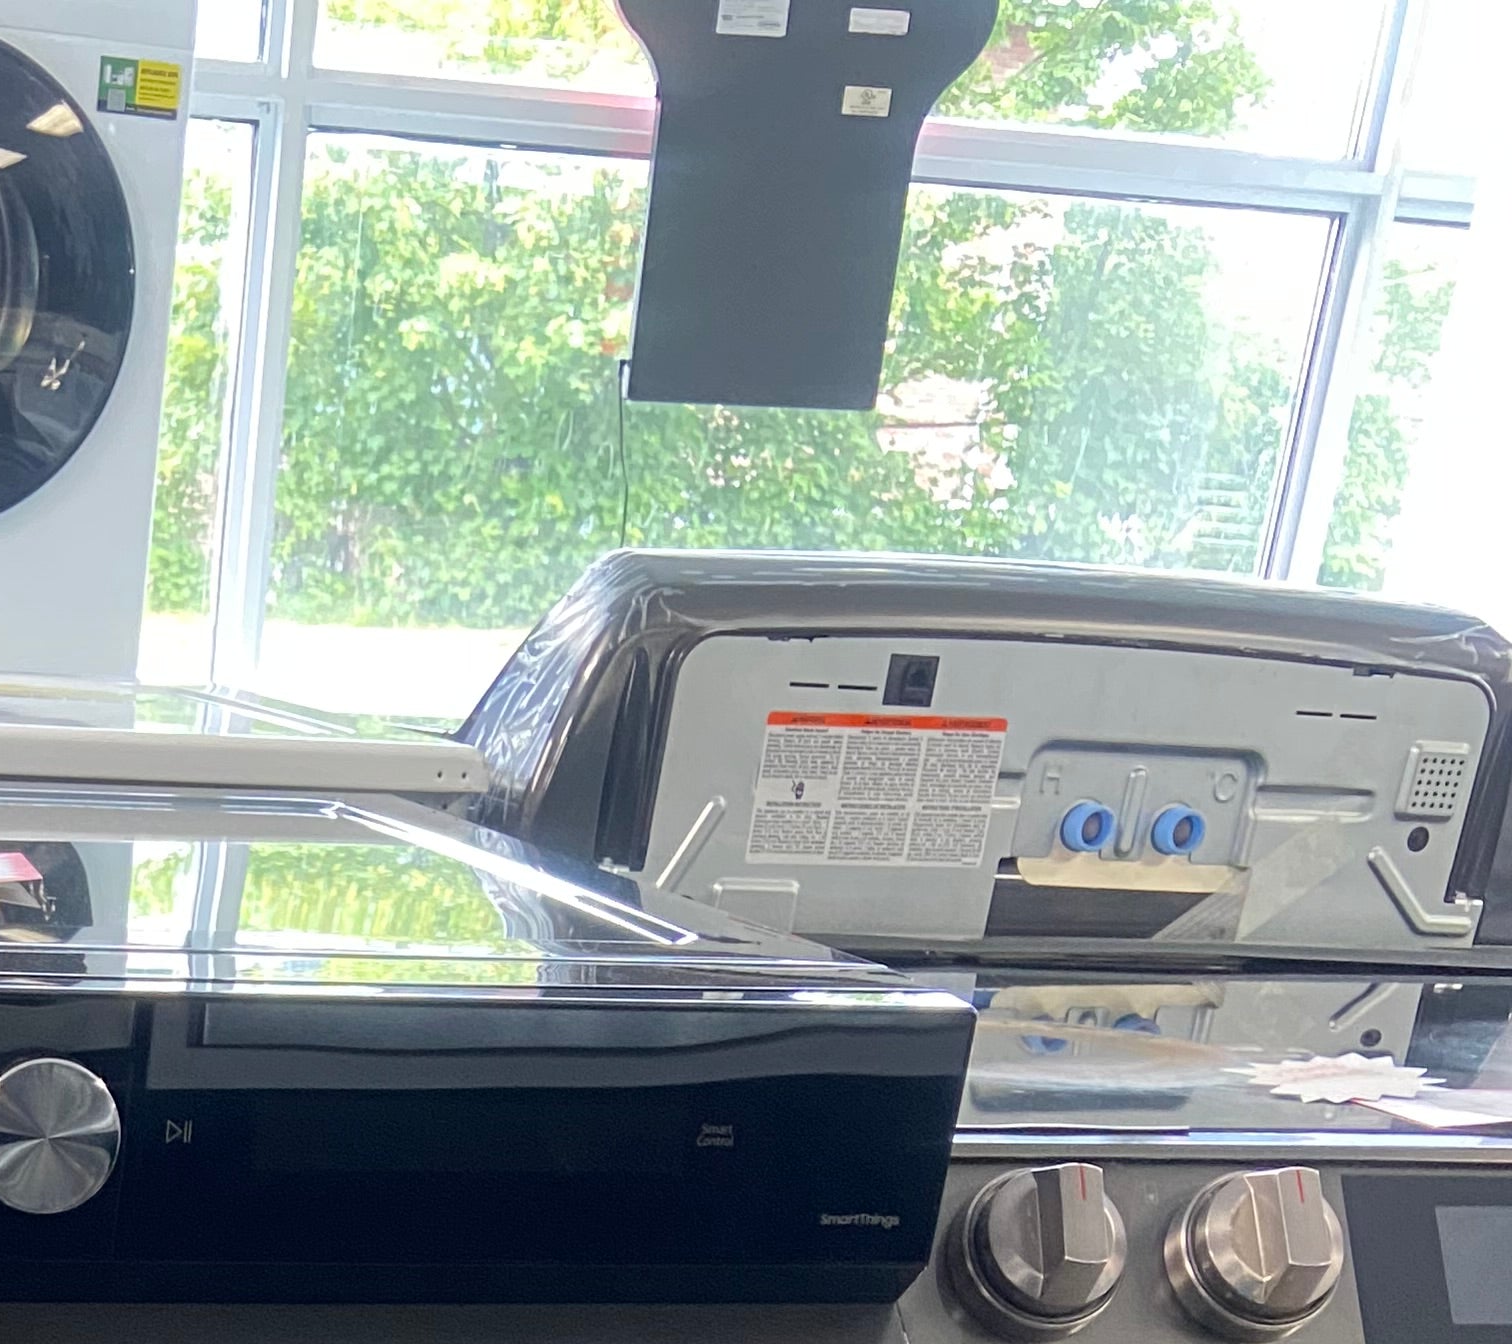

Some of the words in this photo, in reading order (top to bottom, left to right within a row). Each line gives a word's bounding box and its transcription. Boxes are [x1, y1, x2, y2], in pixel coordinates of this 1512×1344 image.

[701, 1122, 733, 1135] Smart
[696, 1134, 735, 1148] Control
[820, 1213, 900, 1230] SmartThings
